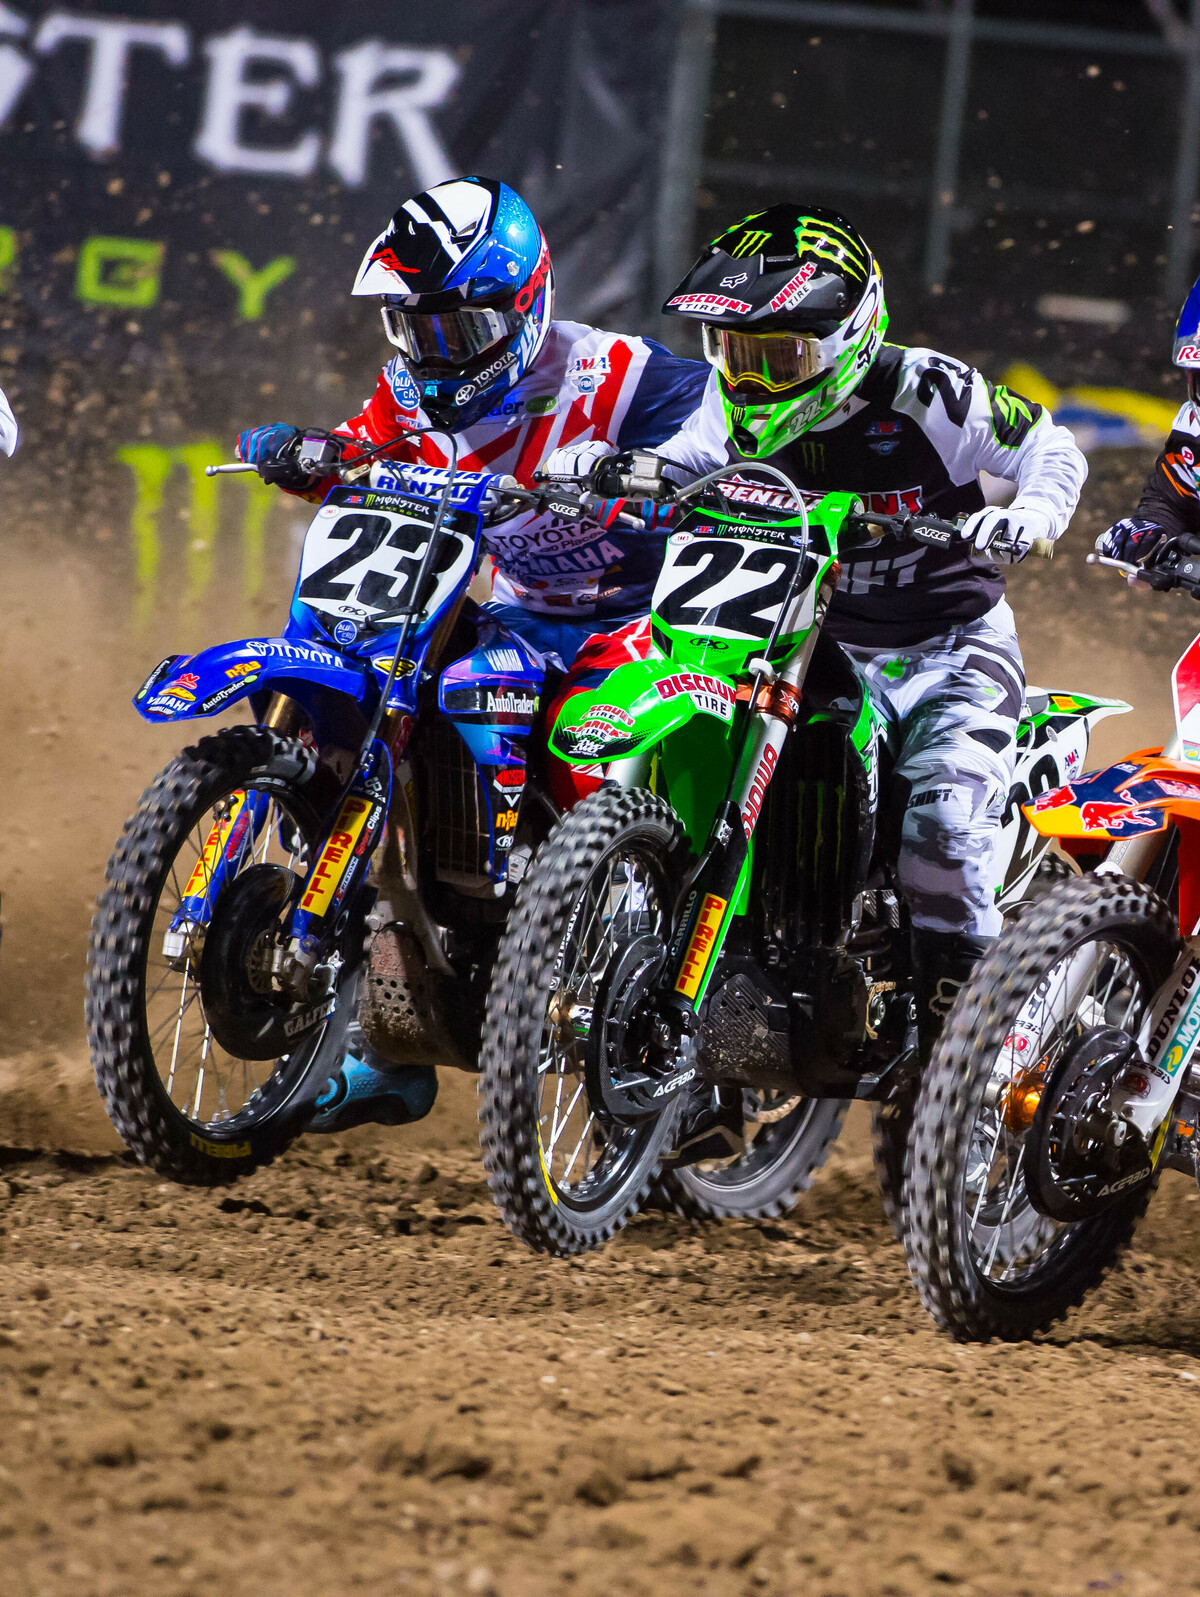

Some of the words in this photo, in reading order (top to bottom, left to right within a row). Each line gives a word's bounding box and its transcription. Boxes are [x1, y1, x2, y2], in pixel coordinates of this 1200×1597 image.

[770, 262, 816, 312] AMERICA'S
[788, 284, 810, 307] TIRE
[669, 294, 752, 314] DISCOUNT
[684, 303, 721, 313] TIRE
[473, 350, 516, 384] TOYOTA
[569, 357, 606, 372] AMA
[791, 400, 822, 436] 22
[375, 495, 430, 515] MONSTER
[713, 481, 822, 512] RENTHA
[549, 503, 579, 516] ARC
[493, 520, 598, 550] TOYOTA
[728, 525, 786, 541] MONSTER
[915, 526, 951, 541] ARC
[300, 513, 464, 613] 23
[655, 541, 819, 641] 22
[272, 645, 344, 668] TOYOTA
[484, 649, 524, 671] YAMAHA
[147, 696, 191, 711] YAMAHA
[202, 680, 245, 711] AutoTrader
[486, 691, 534, 714] AutoTrader
[694, 693, 728, 716] TIRE
[590, 711, 616, 721] TIRE
[584, 728, 607, 740] IRE
[303, 798, 366, 908] PIRELLI
[671, 889, 699, 957] CARRILLO
[676, 896, 724, 991] PIRELLI
[653, 1068, 697, 1098] ACERBIS
[1096, 1166, 1151, 1198] ACERBIS
